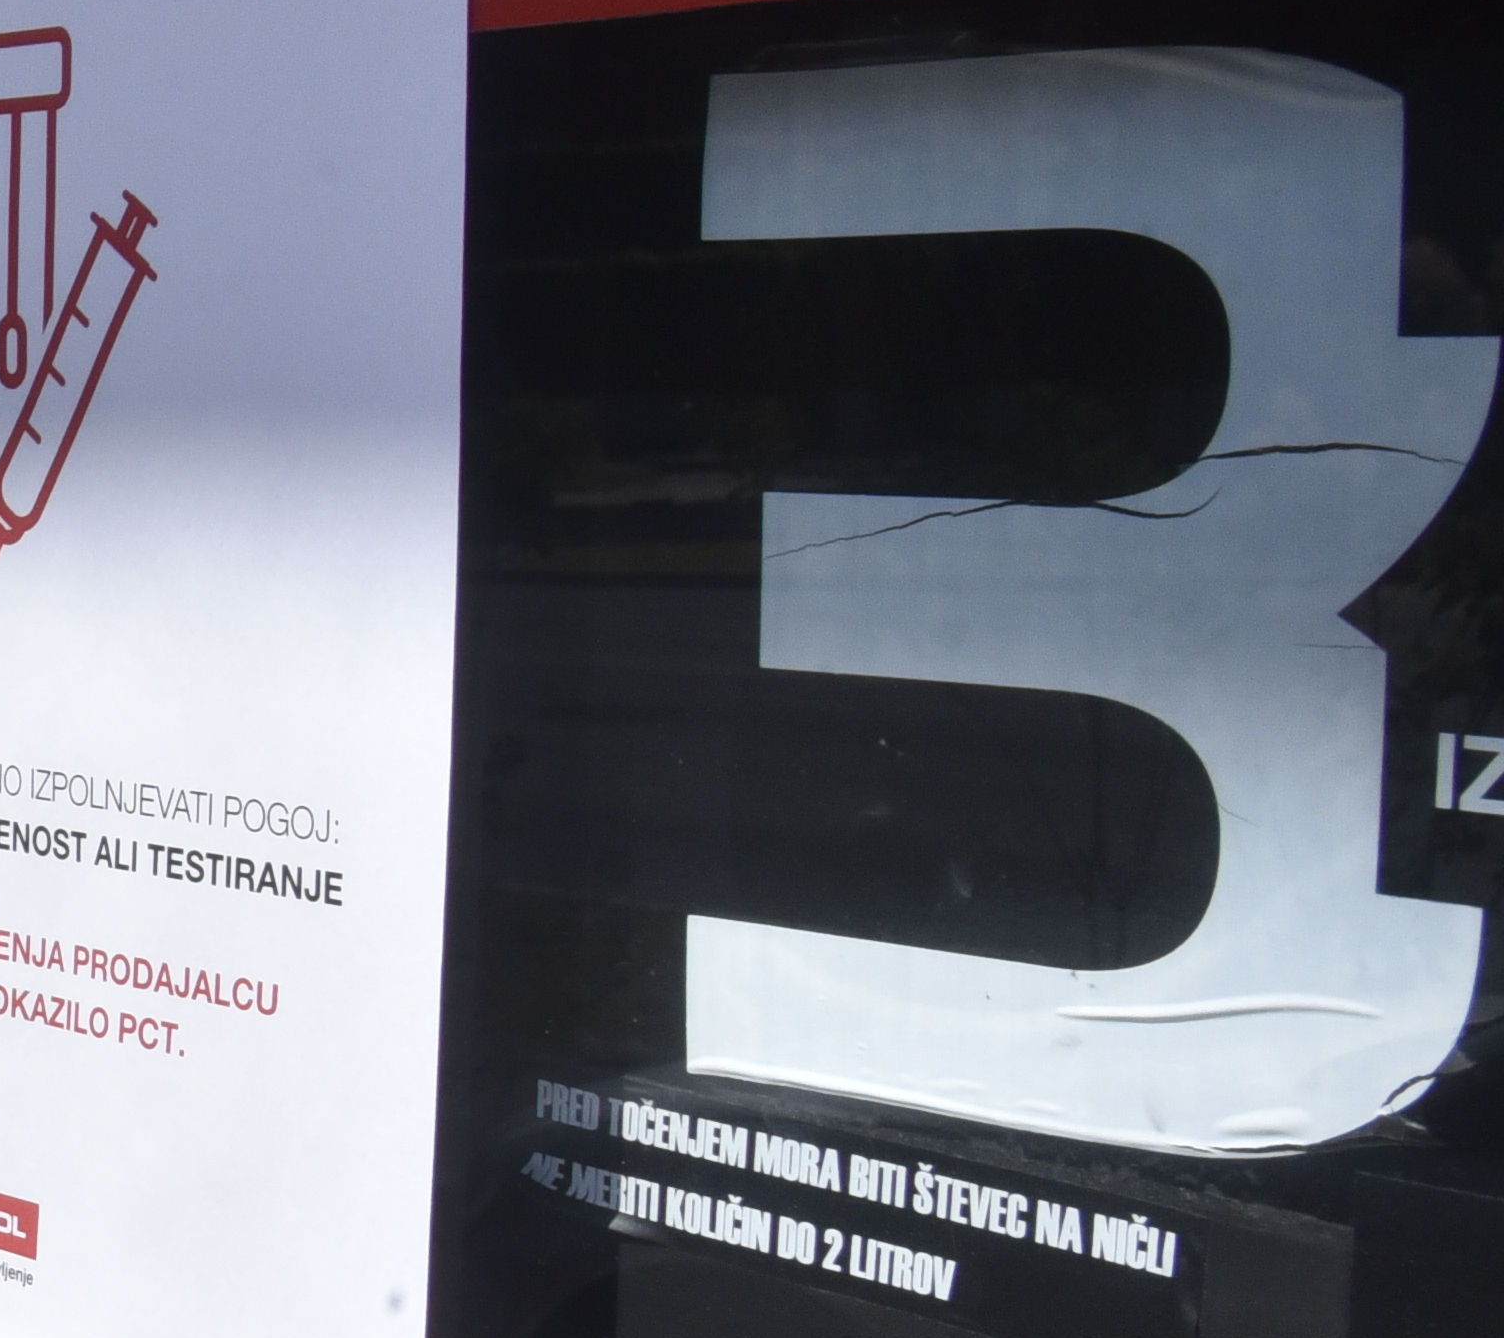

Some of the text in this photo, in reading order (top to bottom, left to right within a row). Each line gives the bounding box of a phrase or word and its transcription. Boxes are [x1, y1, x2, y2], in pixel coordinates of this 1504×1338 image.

[30, 767, 215, 827] IZPOLNJEVATI
[223, 794, 341, 846] POGOJ:
[94, 835, 138, 873] ALI
[148, 843, 344, 907] TESTIRANJE
[72, 943, 280, 1016] PRODAJALCU
[118, 1011, 186, 1057] PCT.
[536, 1078, 1178, 1278] PRED TOČENJEM MORA BITI ŠTEVEC NA NIČLI
[520, 1151, 957, 1302] NE MERITI KOLIČIN DO 2 LITROV
